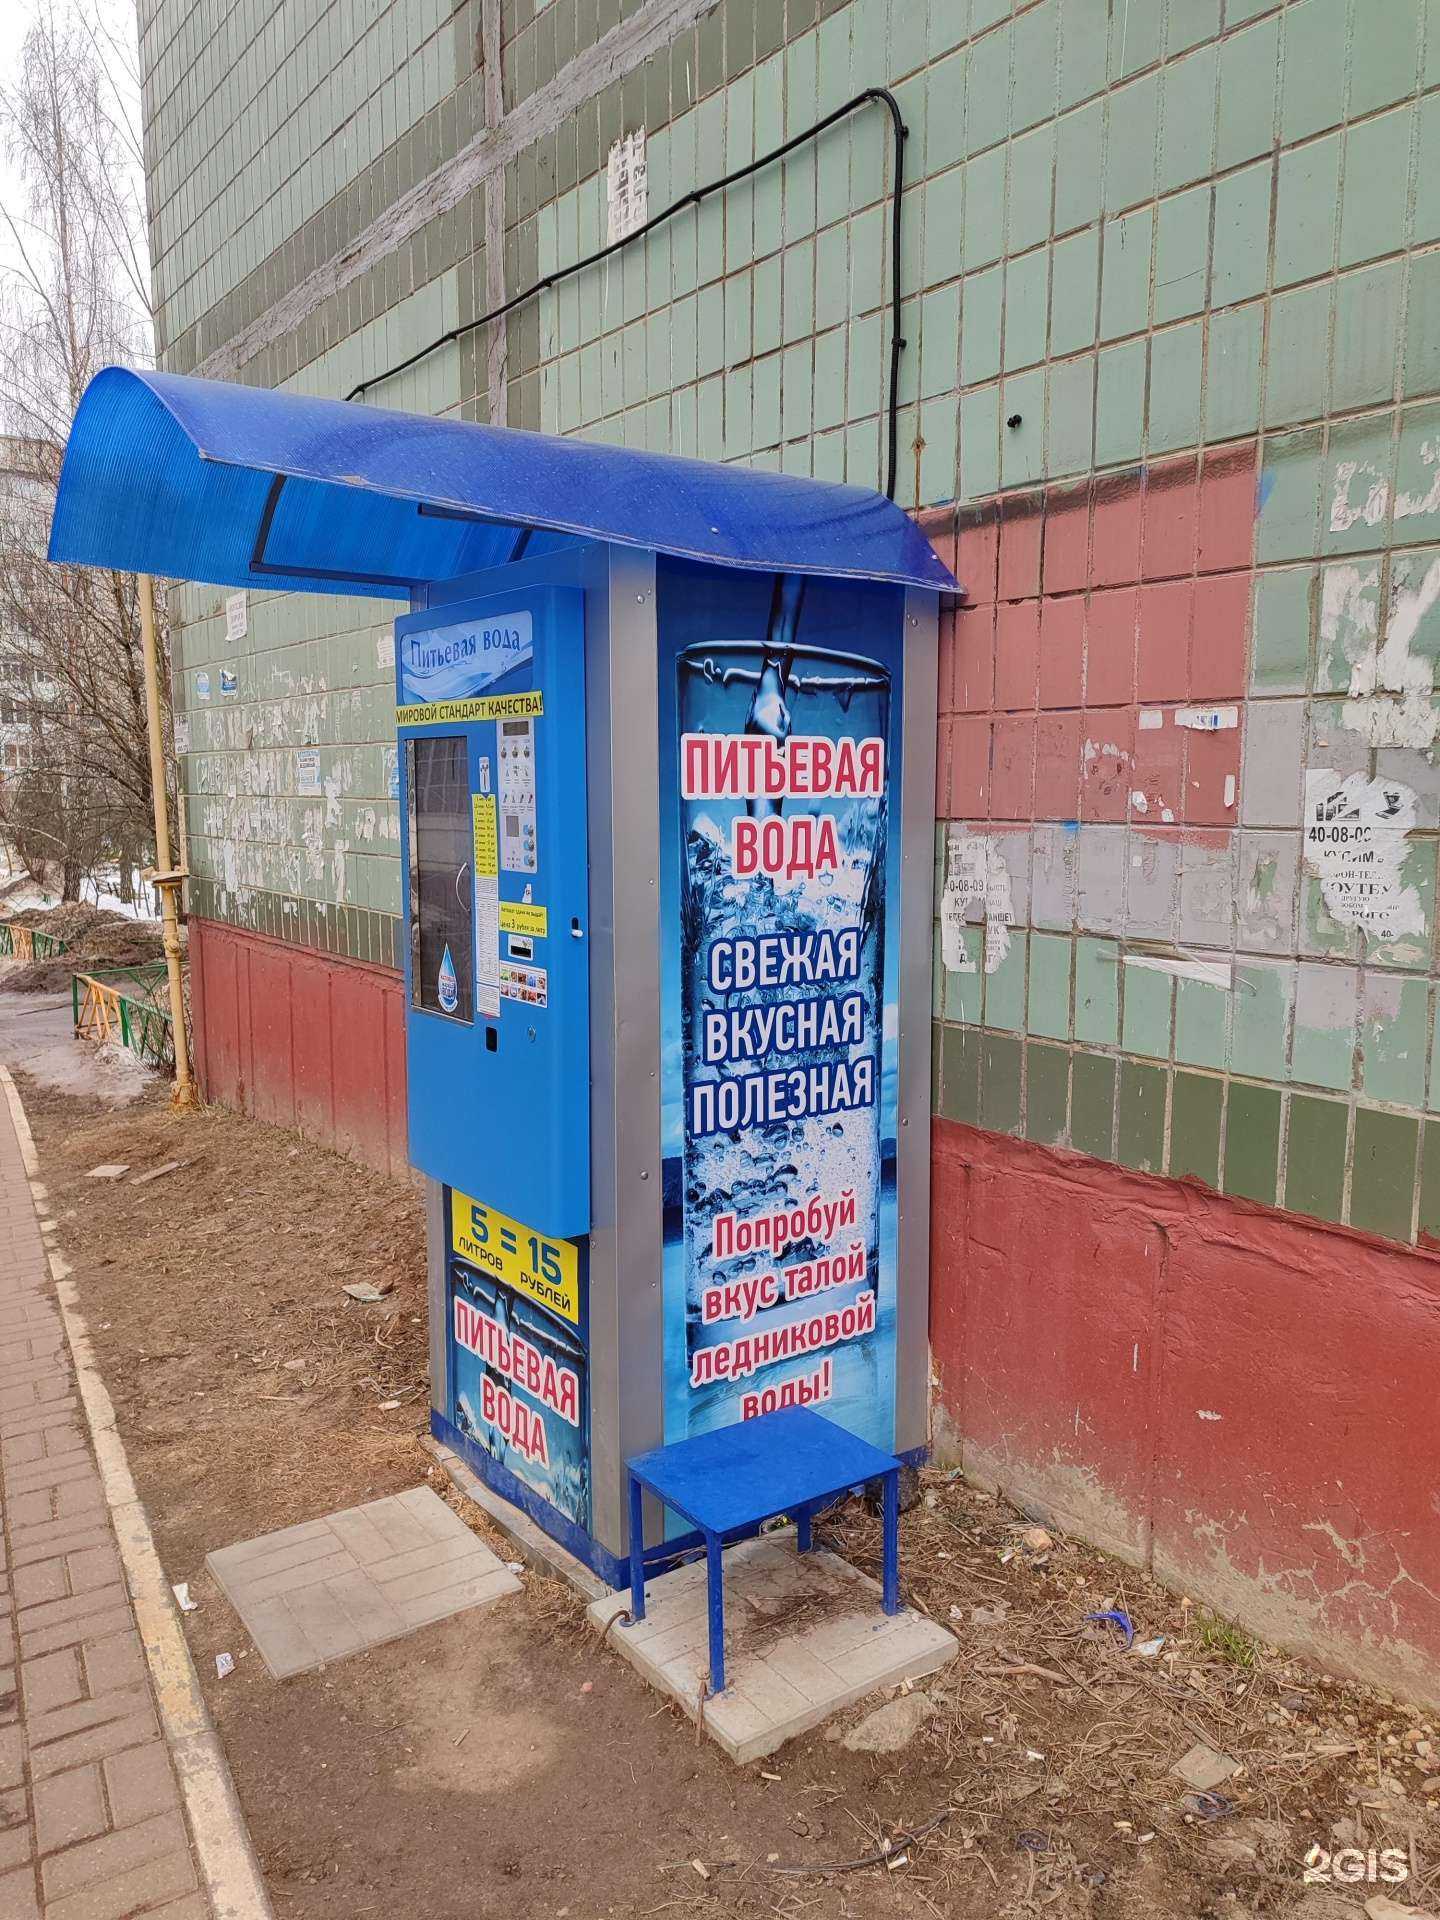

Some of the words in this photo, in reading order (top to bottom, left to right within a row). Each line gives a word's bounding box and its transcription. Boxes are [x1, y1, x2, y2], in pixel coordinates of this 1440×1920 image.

[410, 634, 477, 669] Питьевая
[483, 628, 521, 651] вода
[395, 703, 437, 724] МИРОВОЙ
[438, 701, 486, 720] СТАНДАРТ
[488, 694, 543, 716] КАЧЕСТВА!
[685, 737, 882, 796] ПИТЬЕВАЯ
[735, 818, 840, 882] ВОДА
[710, 931, 859, 991] СВЕЖАЯ
[705, 996, 862, 1063] ВКУСНАЯ
[692, 1059, 873, 1134] ПОЛЕЗНАЯ
[458, 1236, 503, 1271] ЛИТРОВ
[470, 1204, 489, 1244] 5
[527, 1236, 562, 1286] 15
[715, 1188, 856, 1258] Попробуй
[519, 1271, 571, 1313] РУБЛЕЙ
[704, 1274, 776, 1321] вкус
[784, 1241, 866, 1298] талой
[455, 1299, 578, 1423] ПИТЬЕВАЯ
[693, 1293, 874, 1384] ледниковой
[482, 1376, 548, 1465] ВОДА
[742, 1359, 831, 1422] воды!
